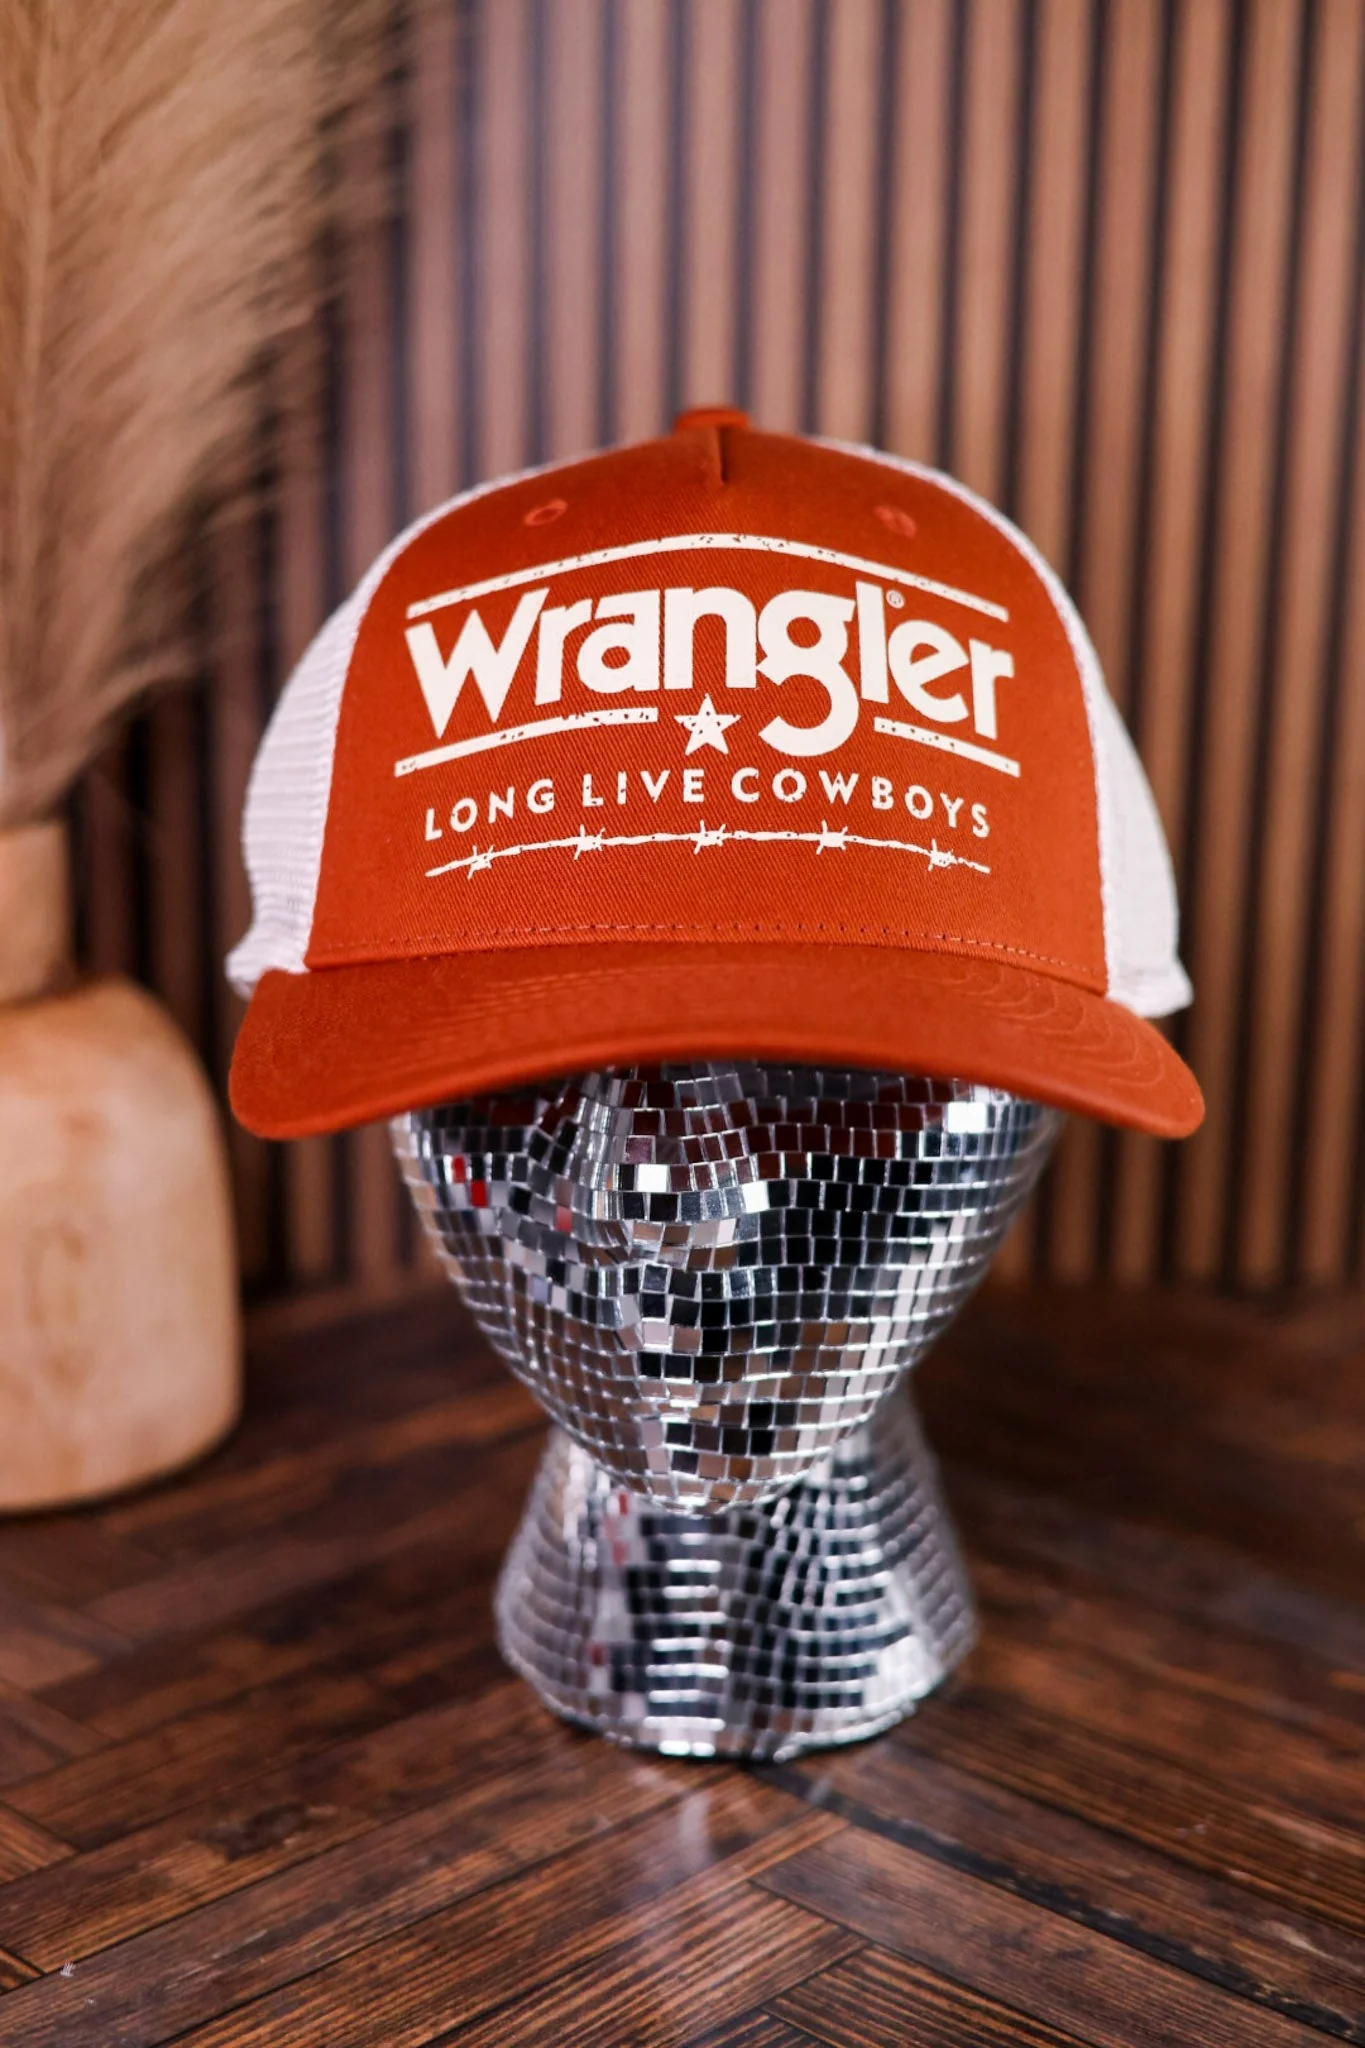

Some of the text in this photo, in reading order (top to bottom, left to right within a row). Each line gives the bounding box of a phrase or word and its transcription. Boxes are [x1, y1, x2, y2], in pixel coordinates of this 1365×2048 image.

[425, 767, 991, 841] LONG LIVE COWBOYS
